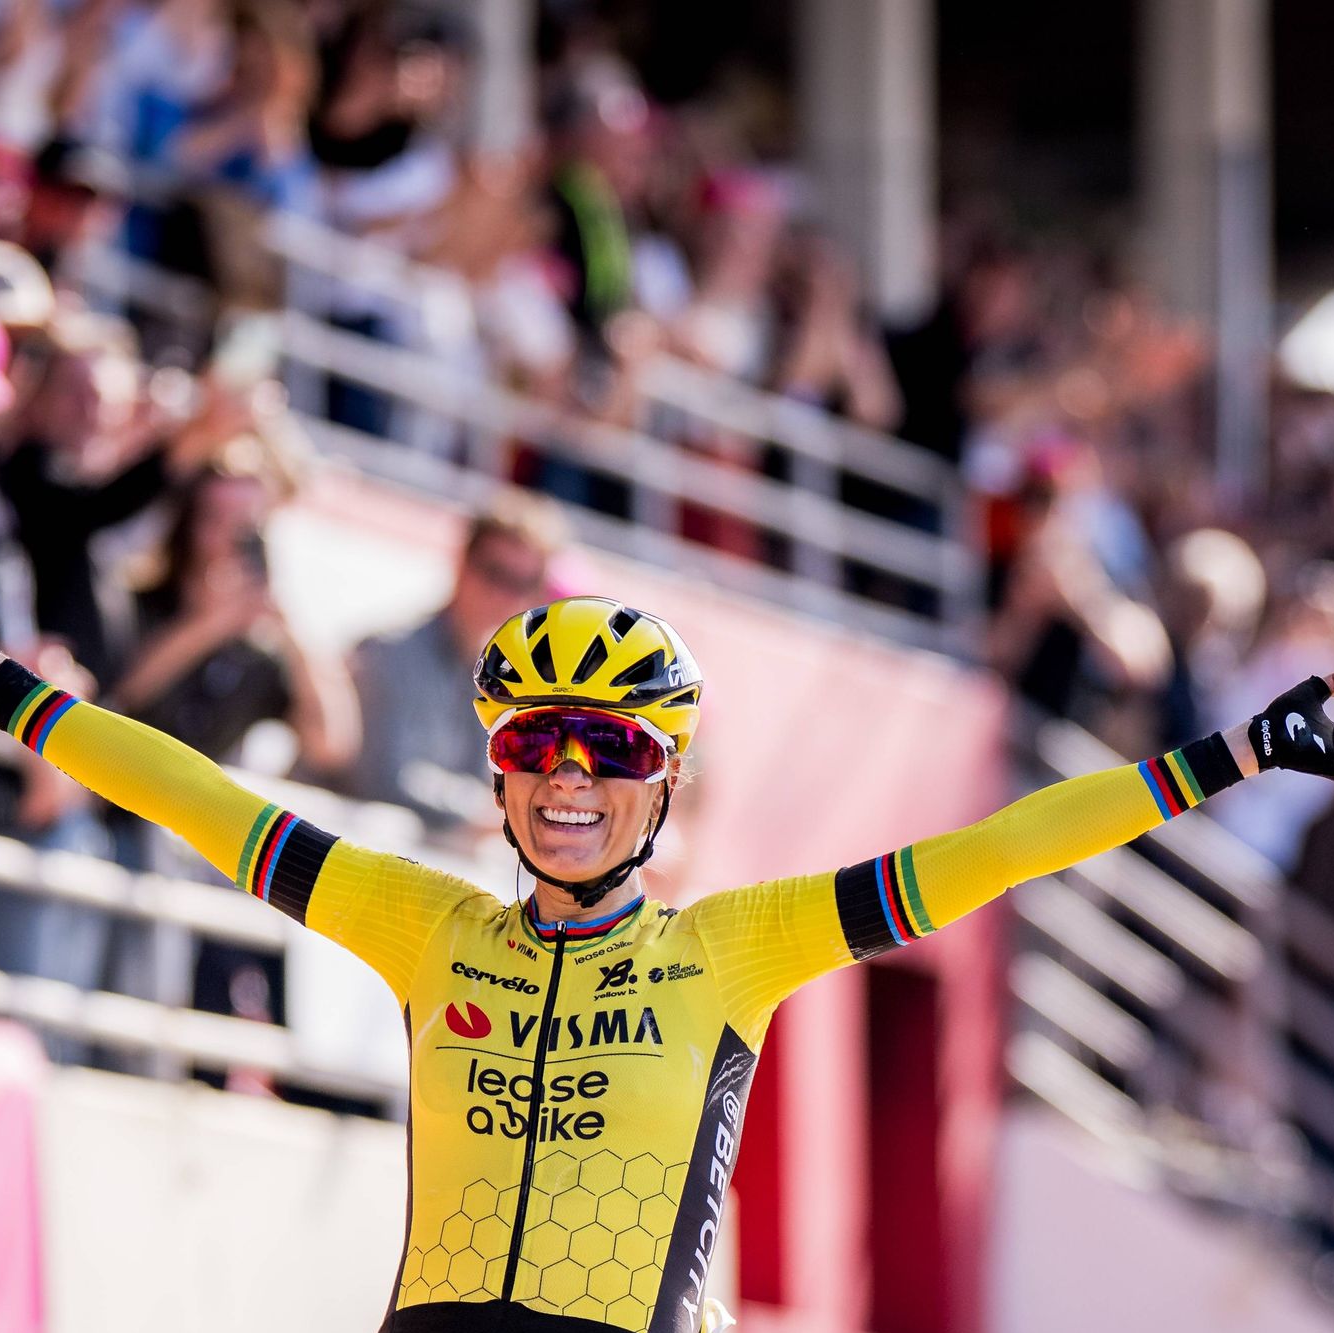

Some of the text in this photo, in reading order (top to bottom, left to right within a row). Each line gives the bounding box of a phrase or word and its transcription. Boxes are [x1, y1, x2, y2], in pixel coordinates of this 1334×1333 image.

[1261, 719, 1273, 756] GripGrab
[517, 942, 538, 962] VISMA
[574, 949, 605, 965] lease
[451, 961, 540, 995] cervélo
[593, 990, 626, 1001] yellow
[510, 1007, 663, 1052] VISMA
[467, 1058, 609, 1104] lease
[682, 1121, 734, 1332] BETCITY
